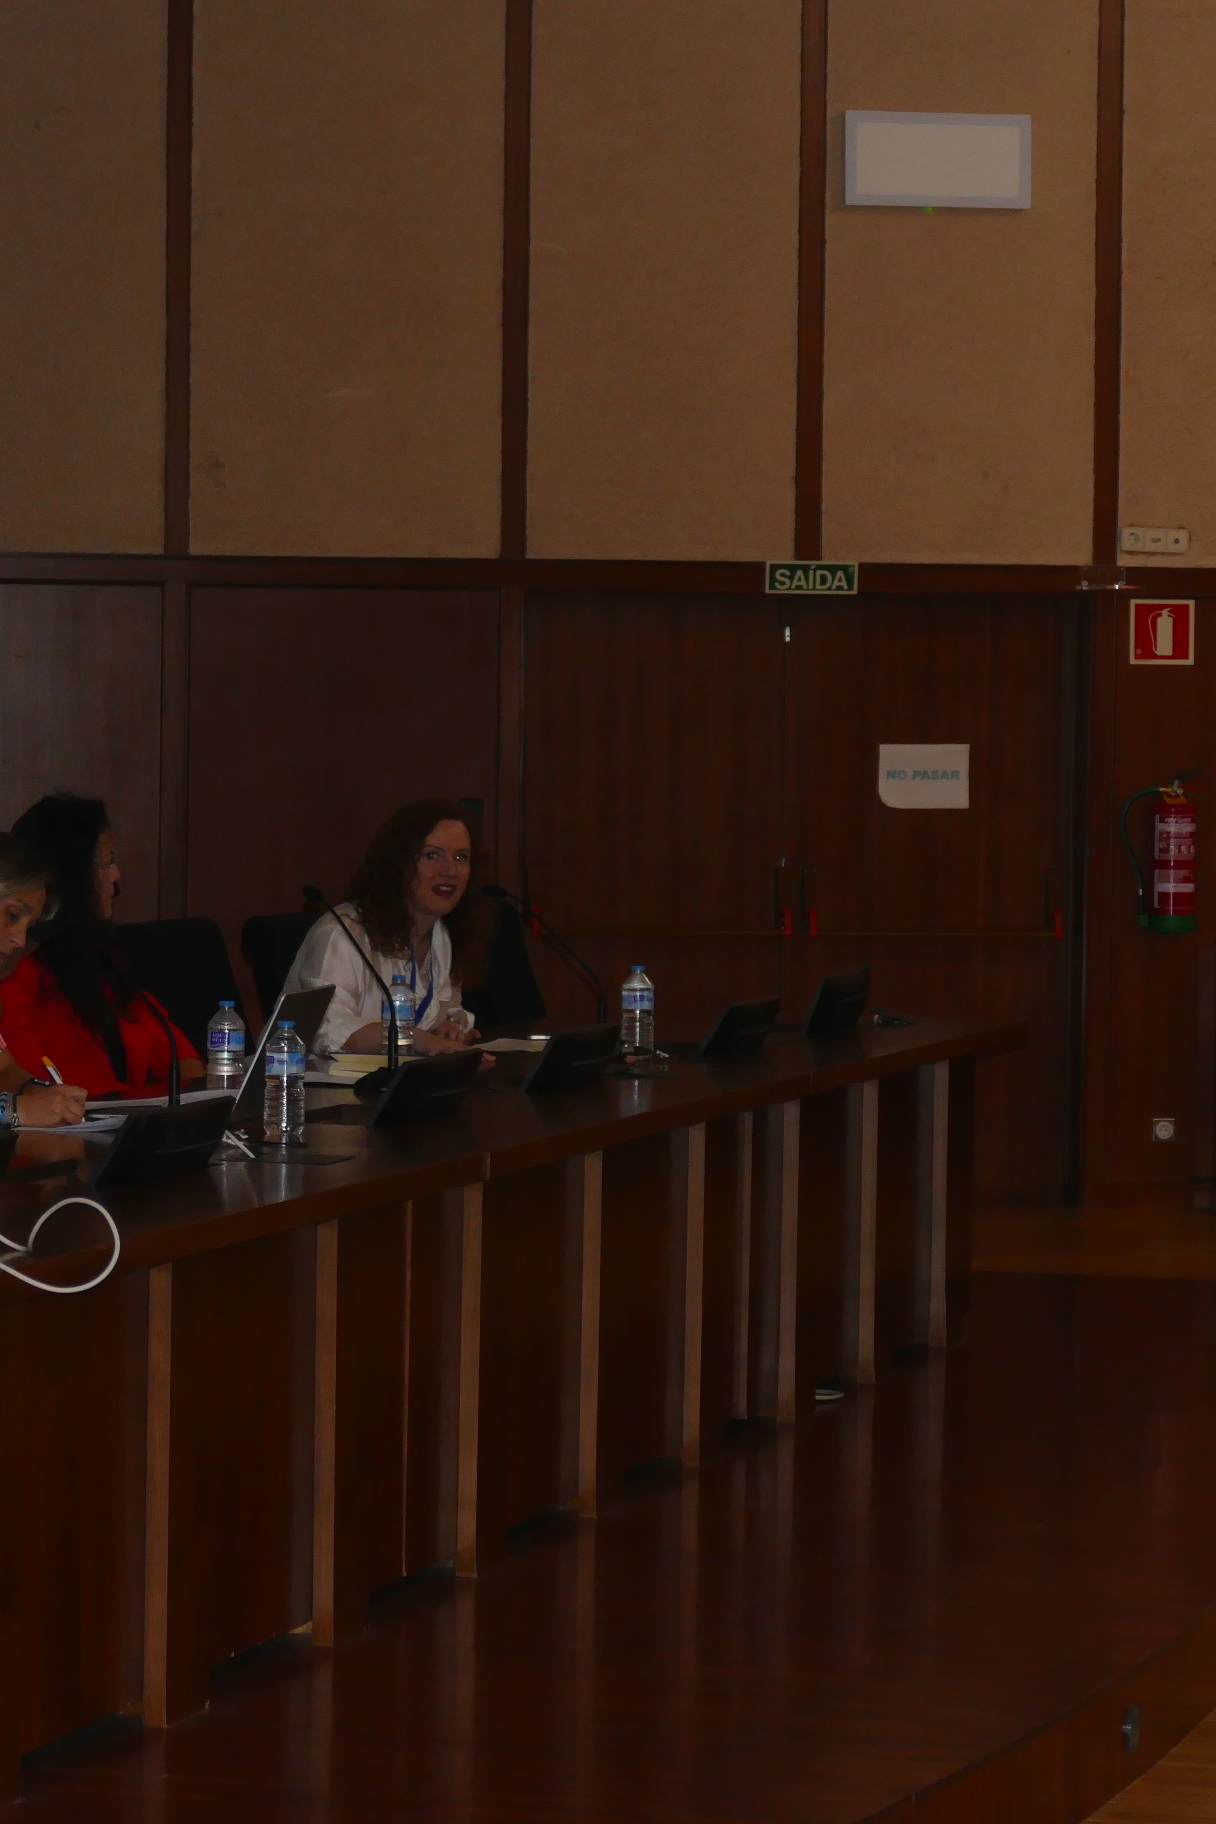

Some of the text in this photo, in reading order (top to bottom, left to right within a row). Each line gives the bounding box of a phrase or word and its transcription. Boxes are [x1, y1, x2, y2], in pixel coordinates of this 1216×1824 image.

[774, 565, 849, 590] SAÍDA
[886, 769, 960, 780] NO PASAR
